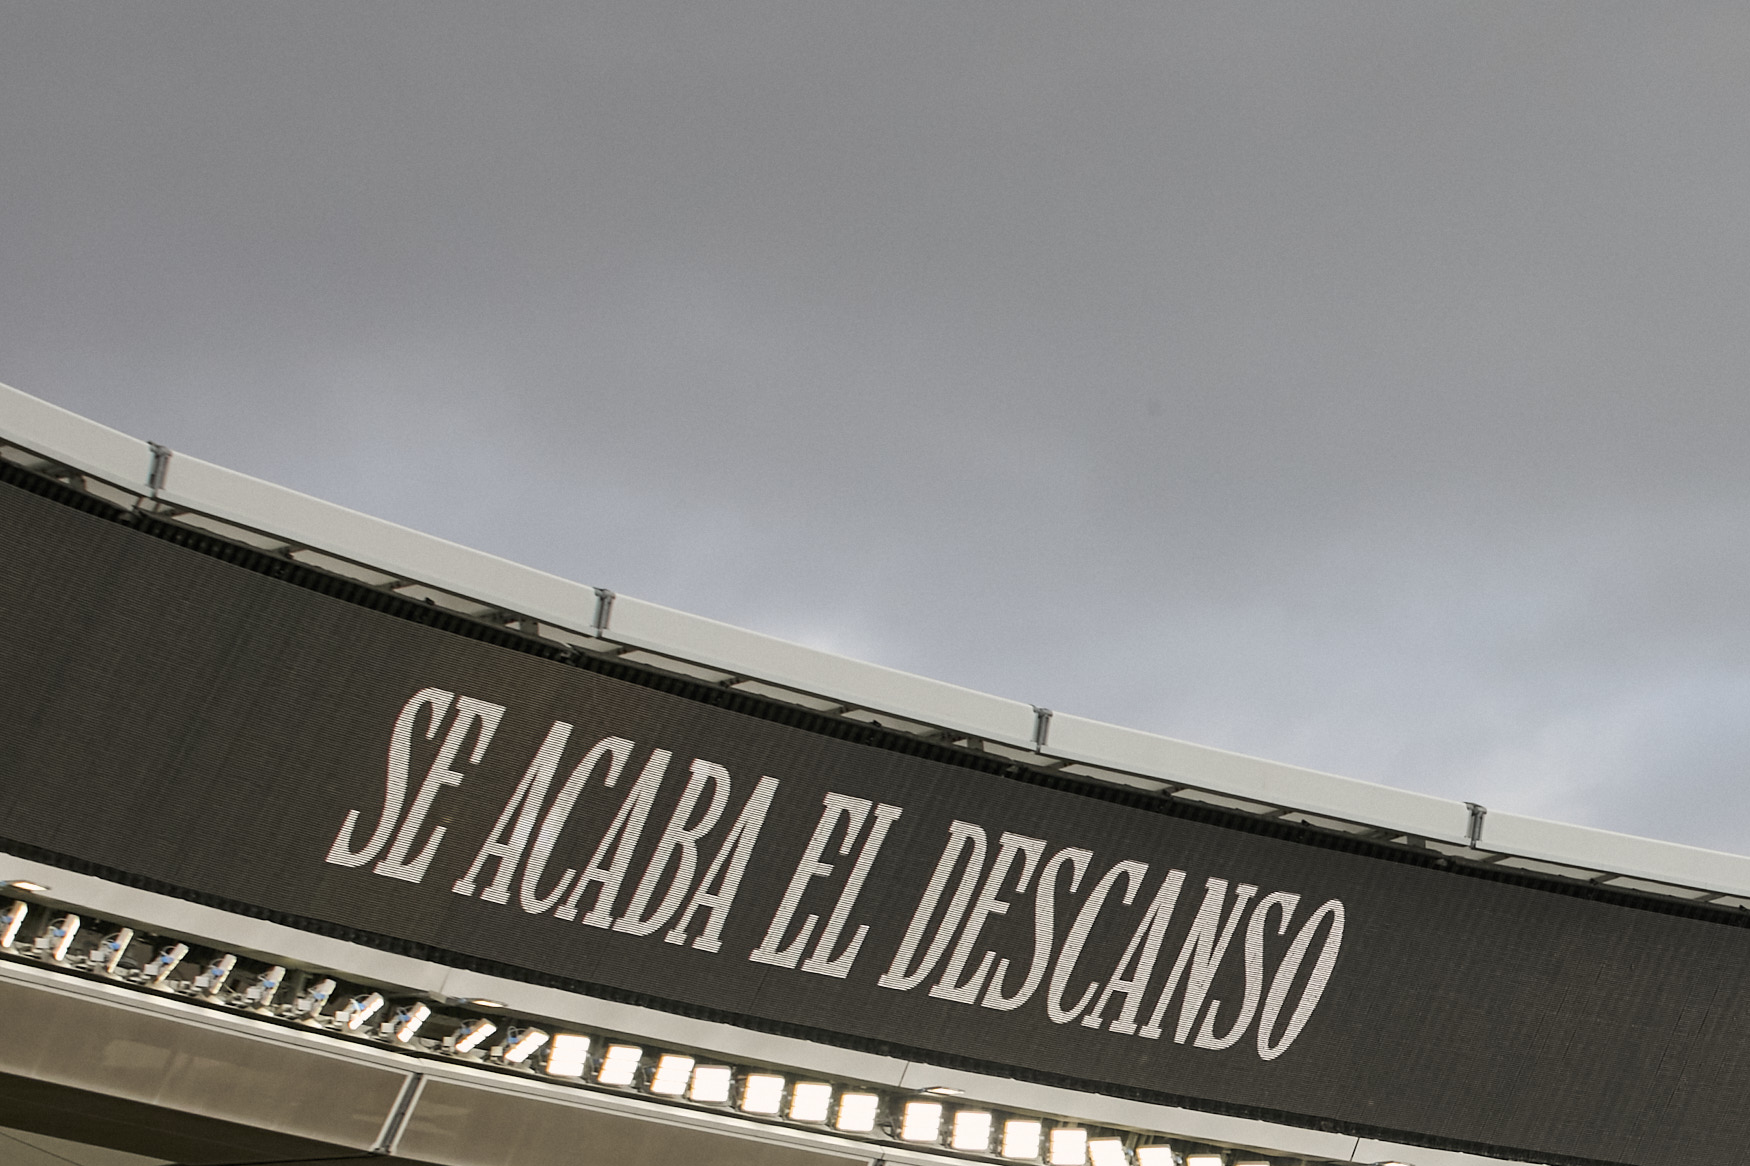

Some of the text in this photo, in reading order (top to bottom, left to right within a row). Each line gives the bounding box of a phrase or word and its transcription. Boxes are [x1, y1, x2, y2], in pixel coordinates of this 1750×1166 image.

[325, 686, 1346, 1062] SE ACABA EL DESCANSO
